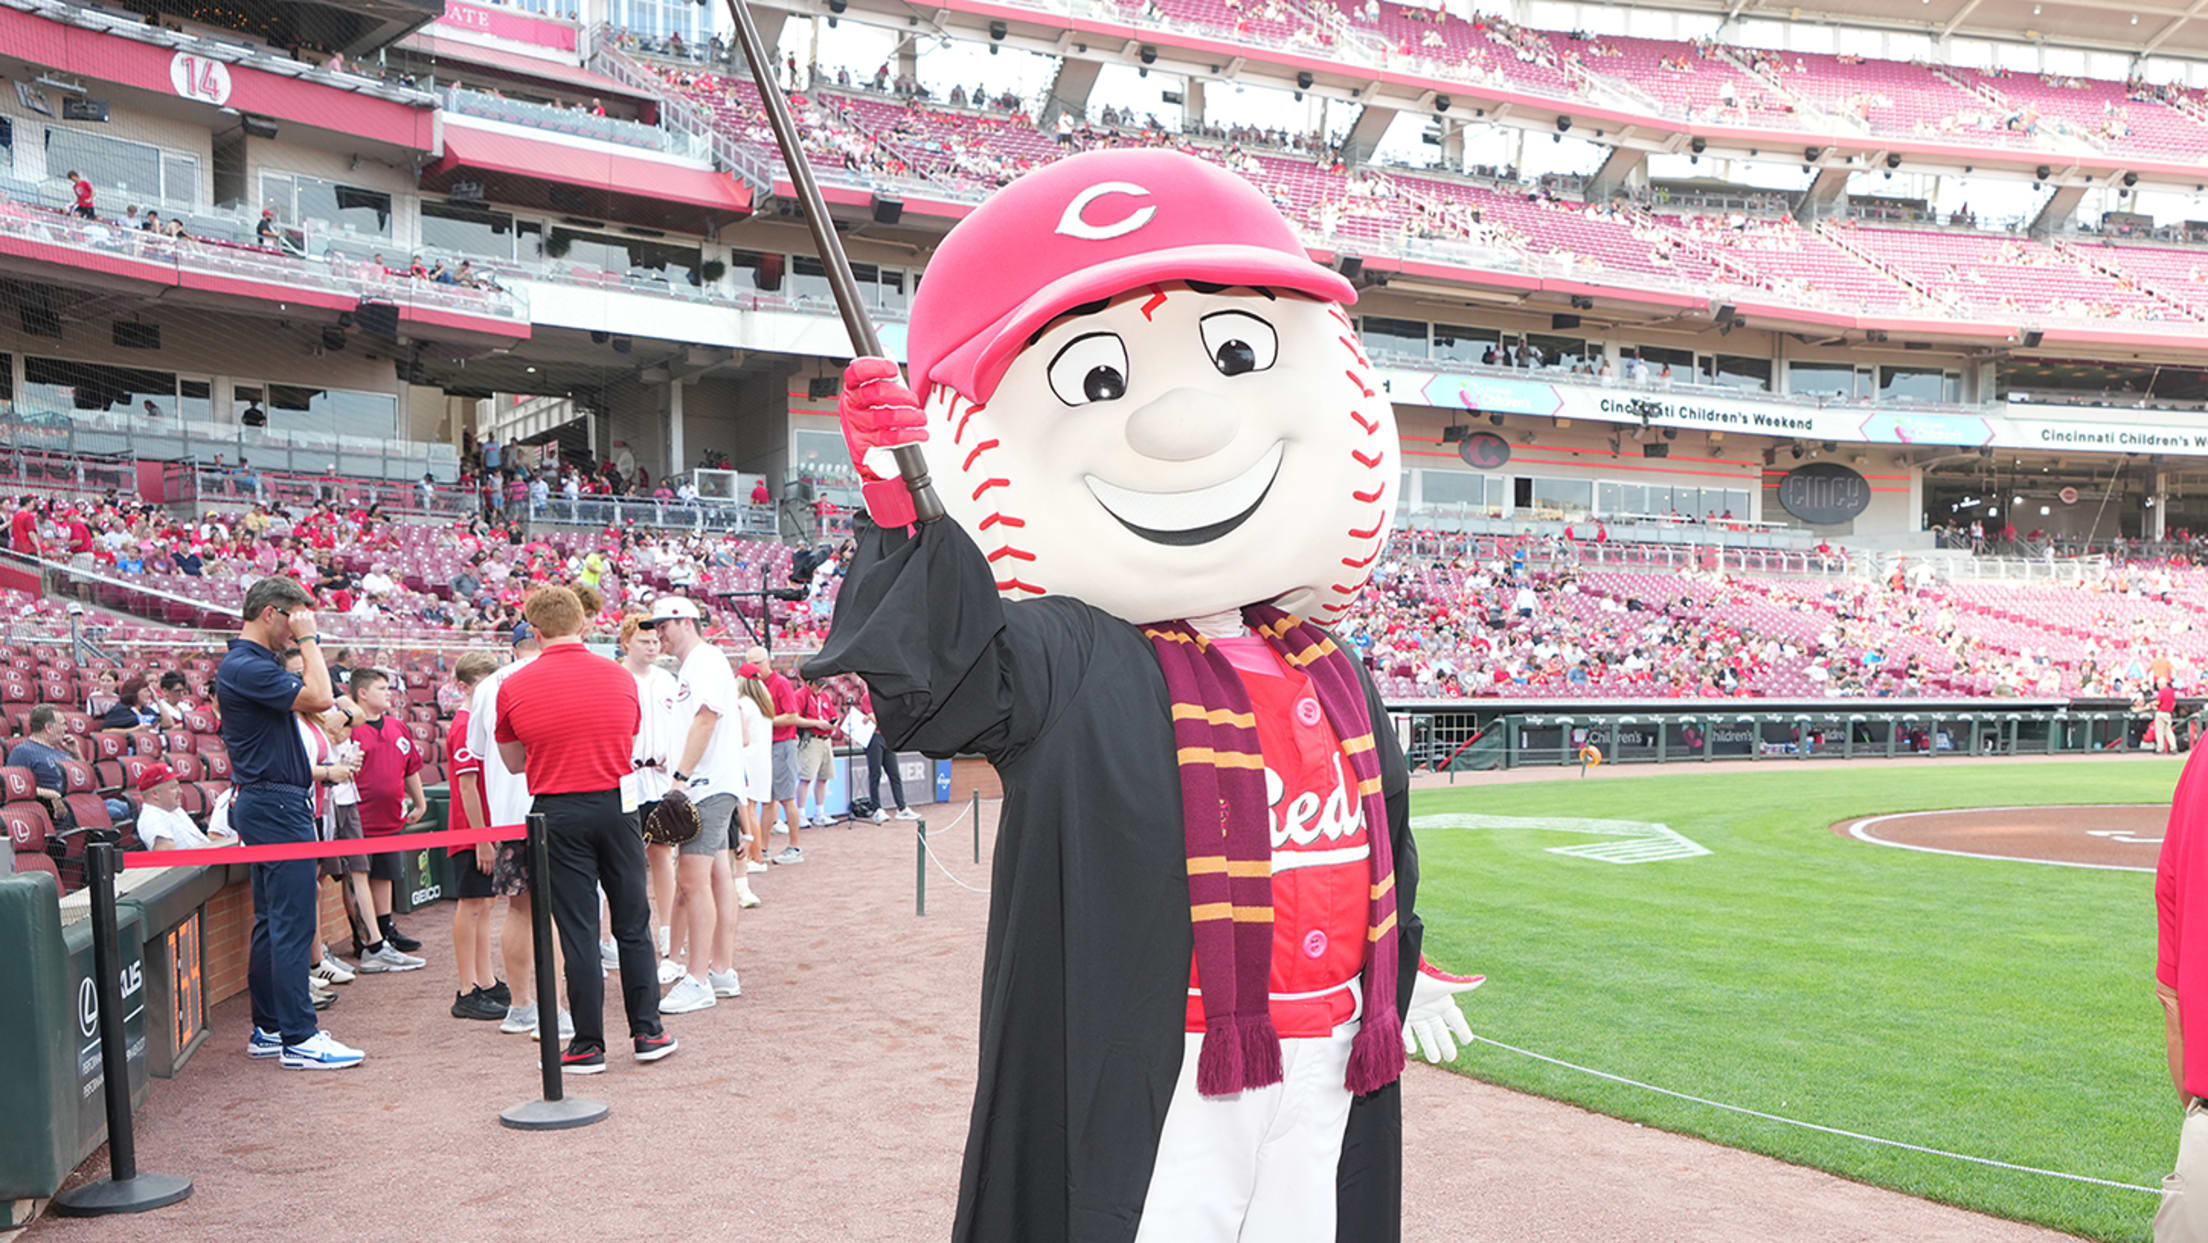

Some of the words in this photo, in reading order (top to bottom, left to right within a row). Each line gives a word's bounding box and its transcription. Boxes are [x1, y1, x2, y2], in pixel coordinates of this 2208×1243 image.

[445, 5, 489, 27] ATE
[180, 57, 220, 101] 14
[1053, 181, 1157, 240] C
[1600, 399, 1675, 417] Cincti
[1679, 407, 1748, 425] Children's
[1753, 413, 1813, 430] Weekend
[2041, 429, 2114, 443] Cincinnati
[2119, 433, 2188, 446] Children's
[2194, 435, 2208, 446] W
[1589, 730, 1642, 744] Chilren's
[1264, 752, 1368, 849] Red
[411, 885, 441, 905] GEICO
